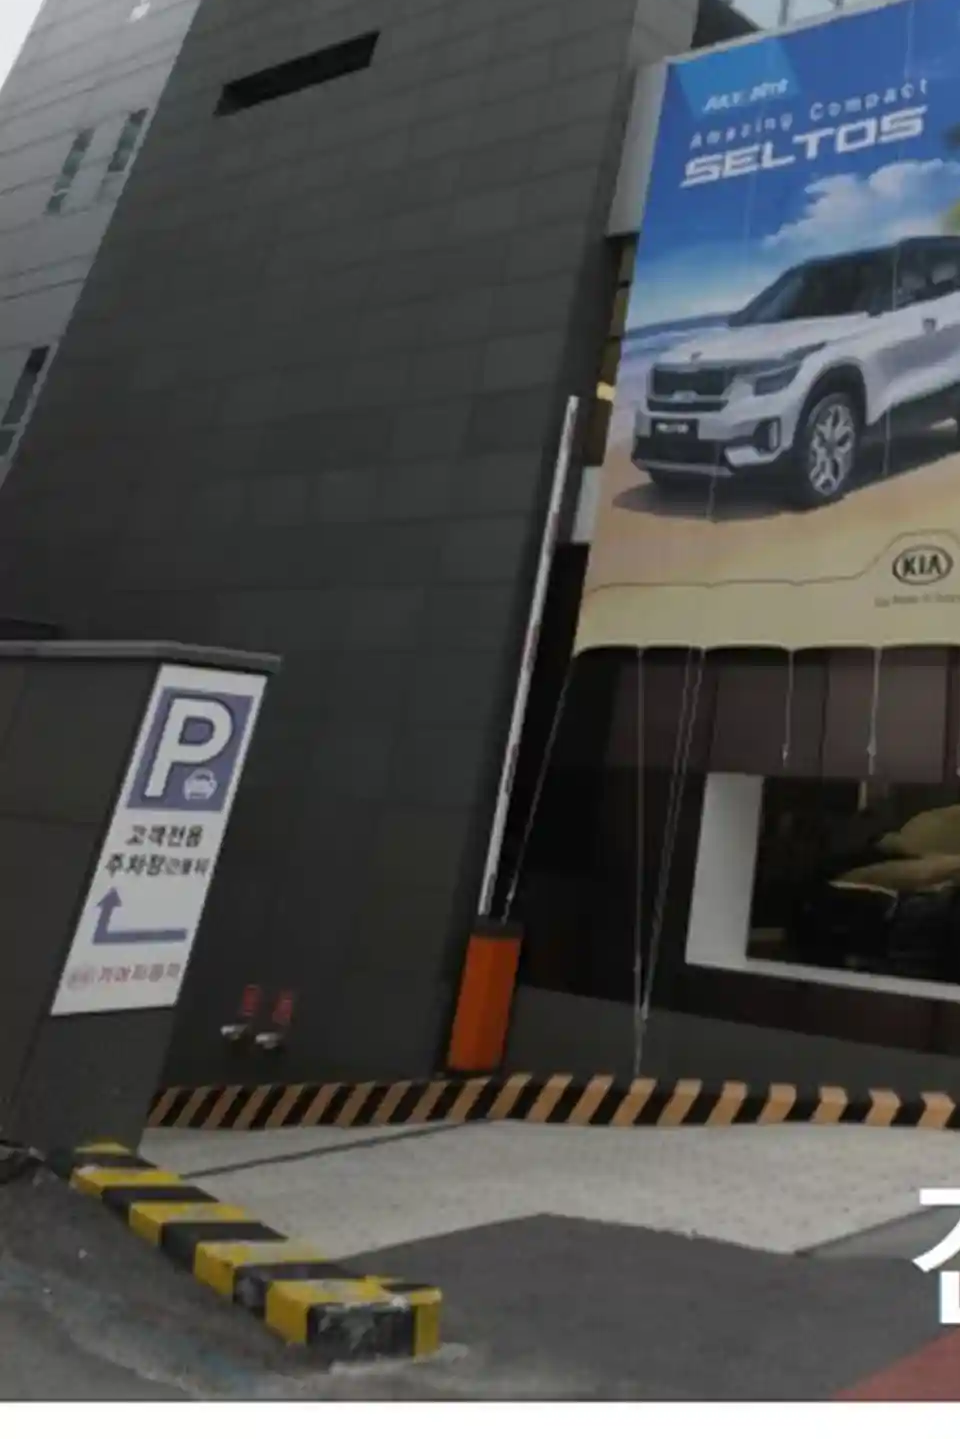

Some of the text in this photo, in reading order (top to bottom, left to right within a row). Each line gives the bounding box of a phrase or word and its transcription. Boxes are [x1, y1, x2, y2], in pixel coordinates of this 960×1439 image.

[679, 105, 928, 189] SELTOS
[690, 79, 928, 150] Amazing Compact
[145, 698, 233, 798] P
[125, 824, 204, 848] 고객전용
